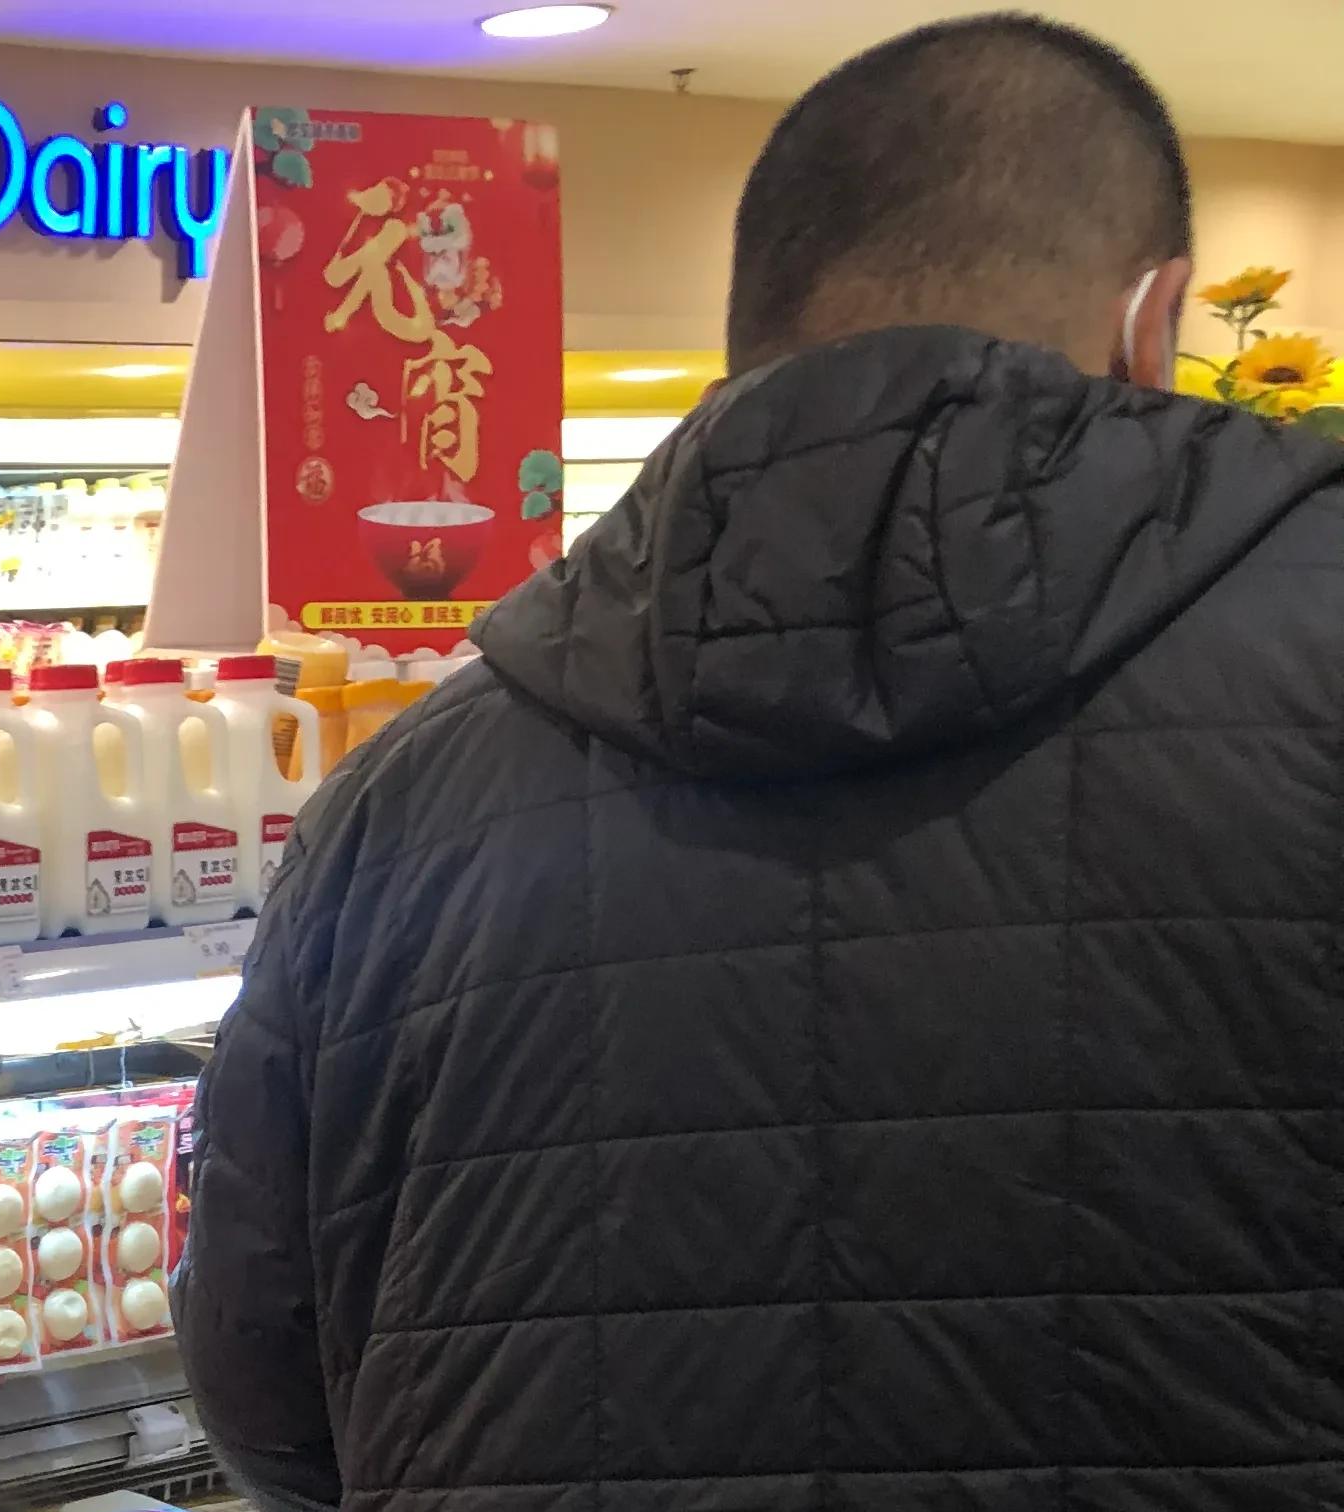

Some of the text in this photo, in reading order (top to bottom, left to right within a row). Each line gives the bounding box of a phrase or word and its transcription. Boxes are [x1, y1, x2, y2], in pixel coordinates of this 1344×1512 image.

[323, 177, 493, 483] 元宵
[371, 606, 414, 624] 安民心
